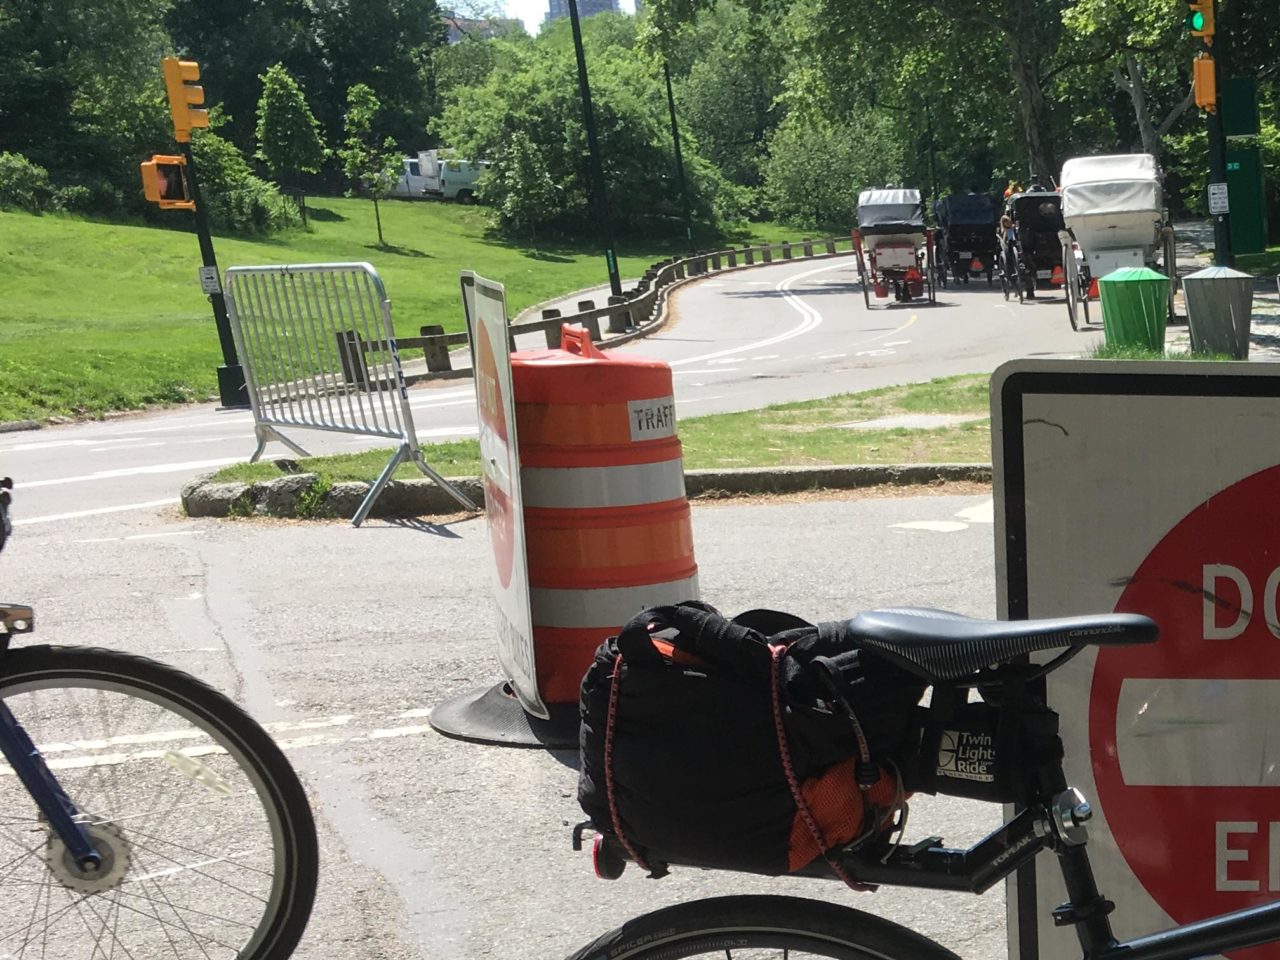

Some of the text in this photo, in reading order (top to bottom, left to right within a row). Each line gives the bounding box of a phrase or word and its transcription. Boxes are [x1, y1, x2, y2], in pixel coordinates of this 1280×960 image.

[960, 732, 991, 746] Twin
[956, 759, 988, 774] Ride
[991, 836, 1031, 866] TOPEAK
